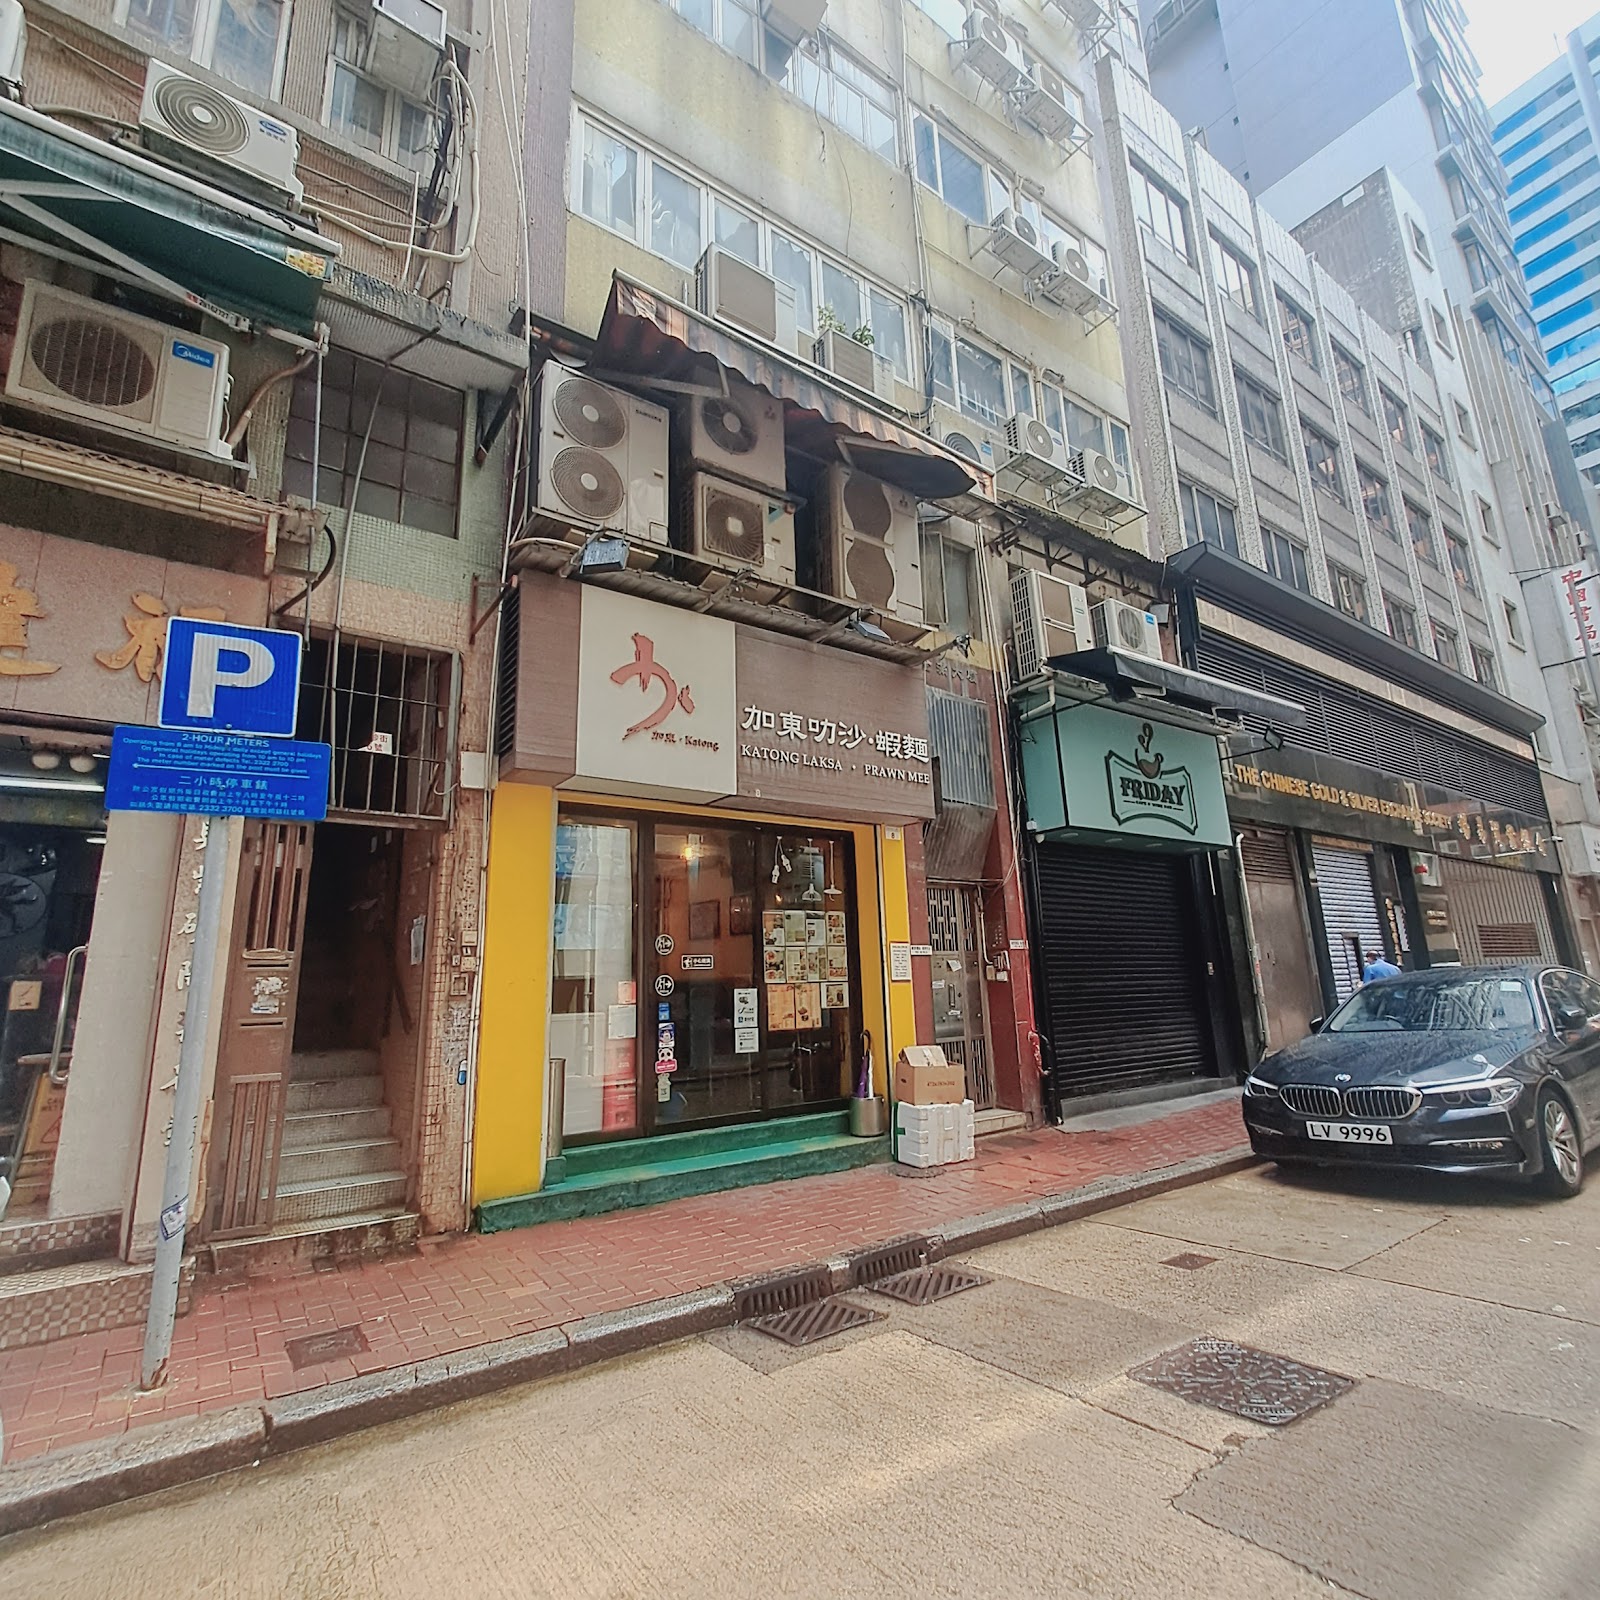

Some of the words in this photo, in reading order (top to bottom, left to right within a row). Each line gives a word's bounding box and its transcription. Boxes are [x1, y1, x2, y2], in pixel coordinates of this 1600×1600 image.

[187, 632, 275, 718] P
[123, 737, 157, 746] Operating
[183, 733, 224, 744] 2-HOUR
[227, 737, 270, 748] METERS
[684, 735, 719, 752] Katong
[180, 748, 207, 756] holidays
[741, 744, 799, 764] KATONG
[802, 754, 843, 771] LAKSA
[864, 763, 905, 780] PRAWN
[907, 771, 930, 784] MEE
[1119, 776, 1186, 806] FRIDAY
[1234, 763, 1261, 787] THE
[1260, 770, 1311, 798] CHINESE
[1310, 782, 1340, 804] GOLD
[1347, 791, 1381, 814] SILVER
[1310, 1123, 1331, 1138] LV
[1339, 1126, 1387, 1142] 9996
